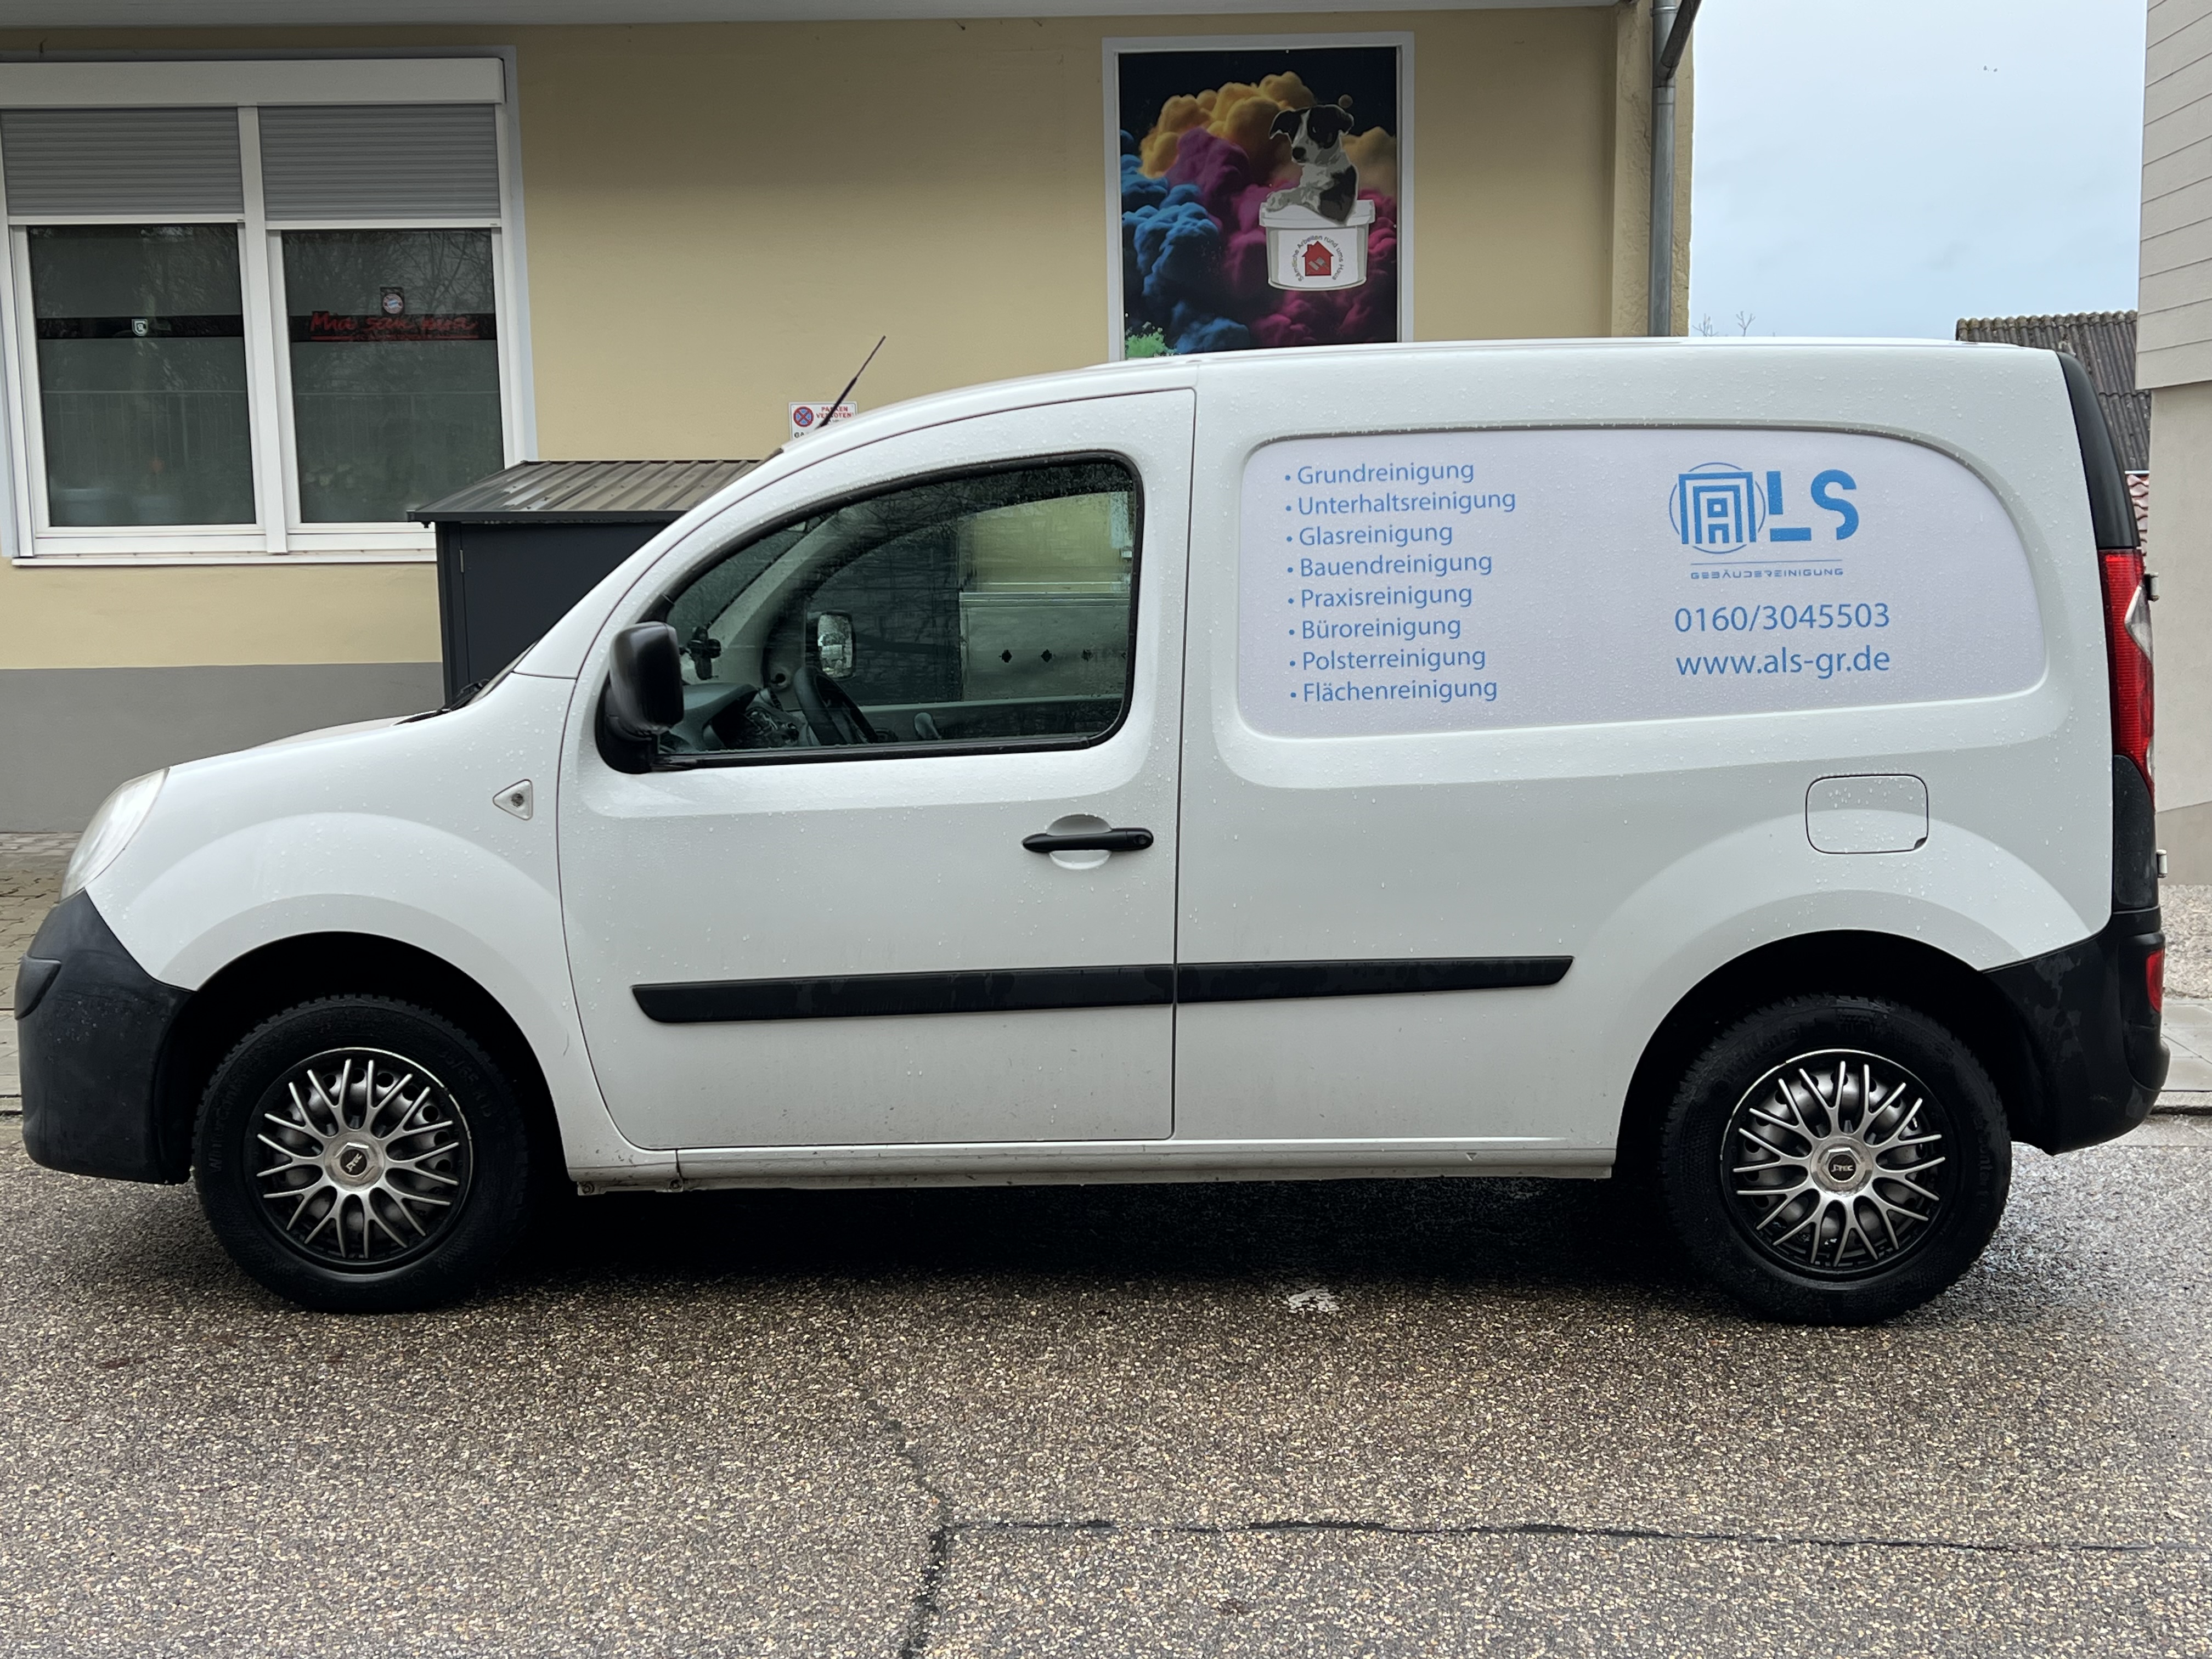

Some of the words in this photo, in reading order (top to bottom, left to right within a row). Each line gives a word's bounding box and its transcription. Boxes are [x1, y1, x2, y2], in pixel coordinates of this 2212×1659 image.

[1323, 236, 1339, 249] rund
[1336, 247, 1344, 263] ums
[1332, 263, 1345, 281] Haus
[1297, 462, 1475, 485] Grundreinigung
[1298, 492, 1516, 516] Unterhaltsreinigung
[1678, 469, 1860, 545] ALS
[1299, 524, 1453, 547] Glasreinigung
[1300, 554, 1493, 577] Bauendreinigung
[1690, 567, 1844, 579] GEBÄUDEREINIGUNG
[1301, 585, 1473, 608] Praxisreinigung
[1674, 602, 1891, 633] 0160/3045503
[1302, 618, 1462, 641] Büroreinigung
[1303, 649, 1486, 672] Polsterreinigung
[1676, 644, 1891, 680] www.als-gr.de
[1304, 681, 1498, 703] Flächenreinigung
